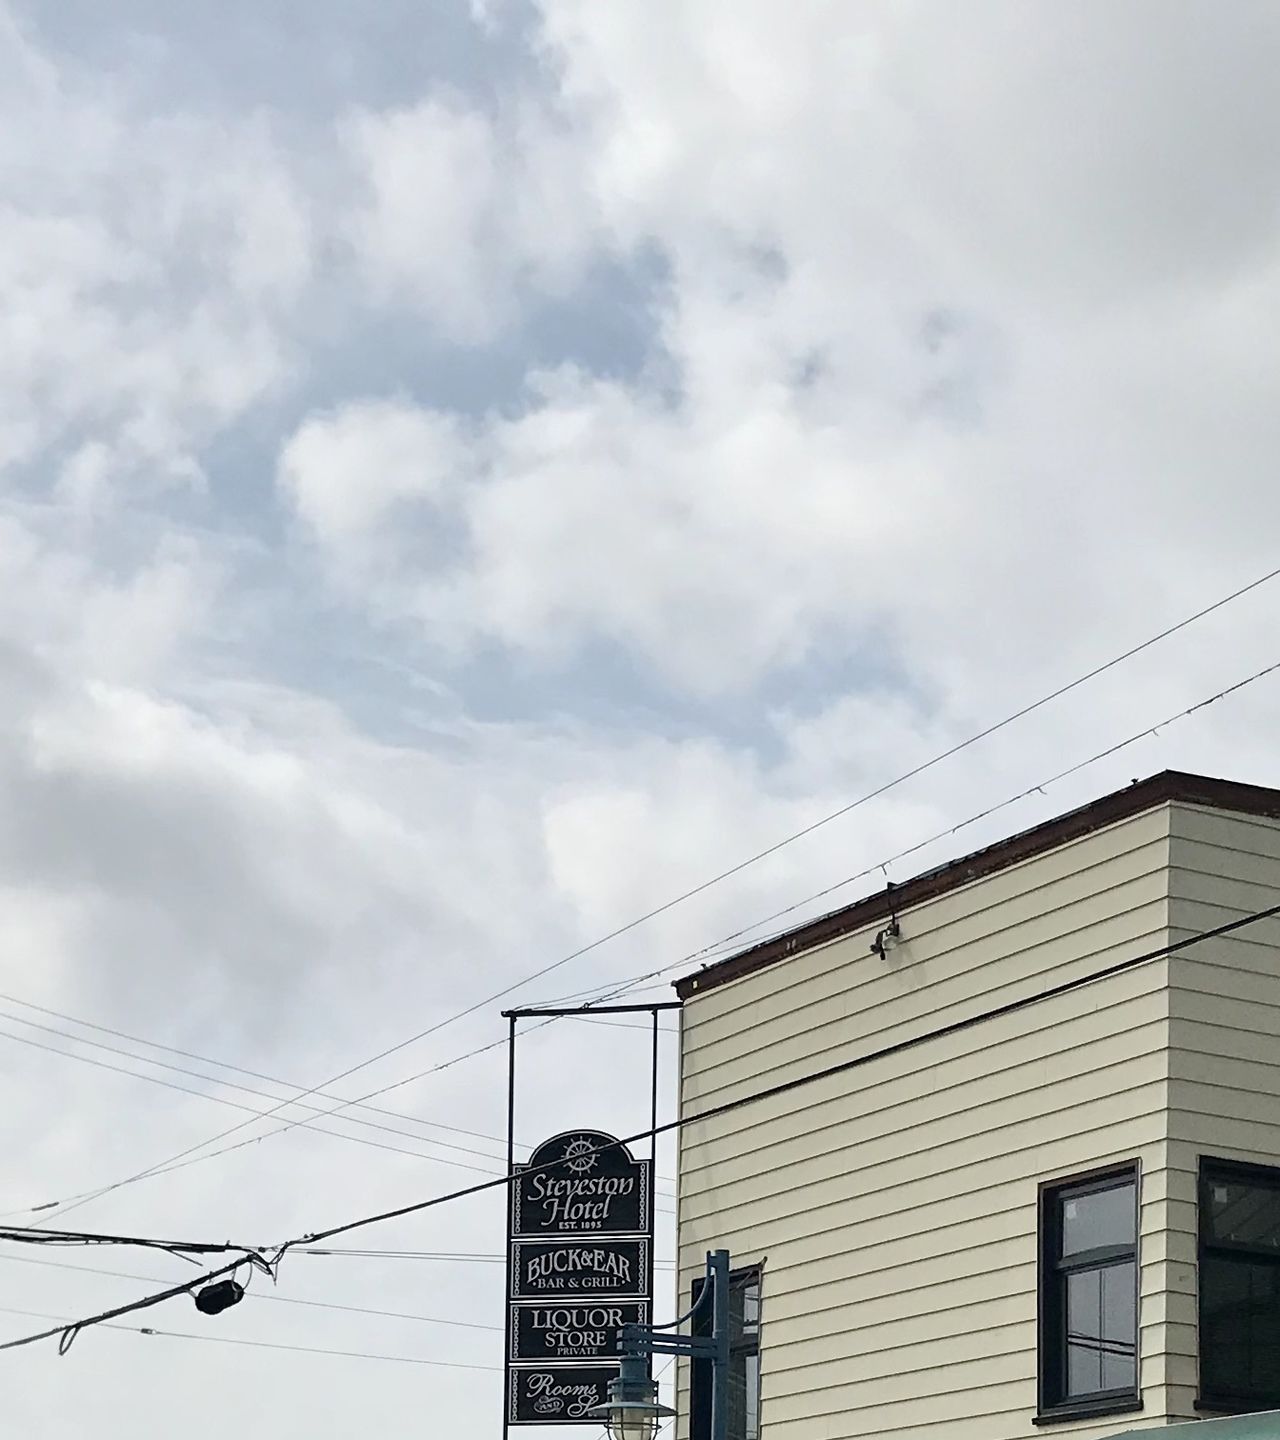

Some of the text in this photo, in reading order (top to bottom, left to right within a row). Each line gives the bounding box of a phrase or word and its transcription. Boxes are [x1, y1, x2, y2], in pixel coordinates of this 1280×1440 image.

[527, 1173, 634, 1201] Steveston
[541, 1192, 611, 1226] Hotel
[559, 1221, 602, 1230] EST. 1895
[527, 1249, 631, 1284] BUCK&EAR
[537, 1277, 621, 1289] BAR & GRILL
[531, 1308, 625, 1332] LIQUOR
[545, 1331, 607, 1348] STORE
[557, 1347, 598, 1356] PRIVATE
[526, 1373, 597, 1398] Rooms
